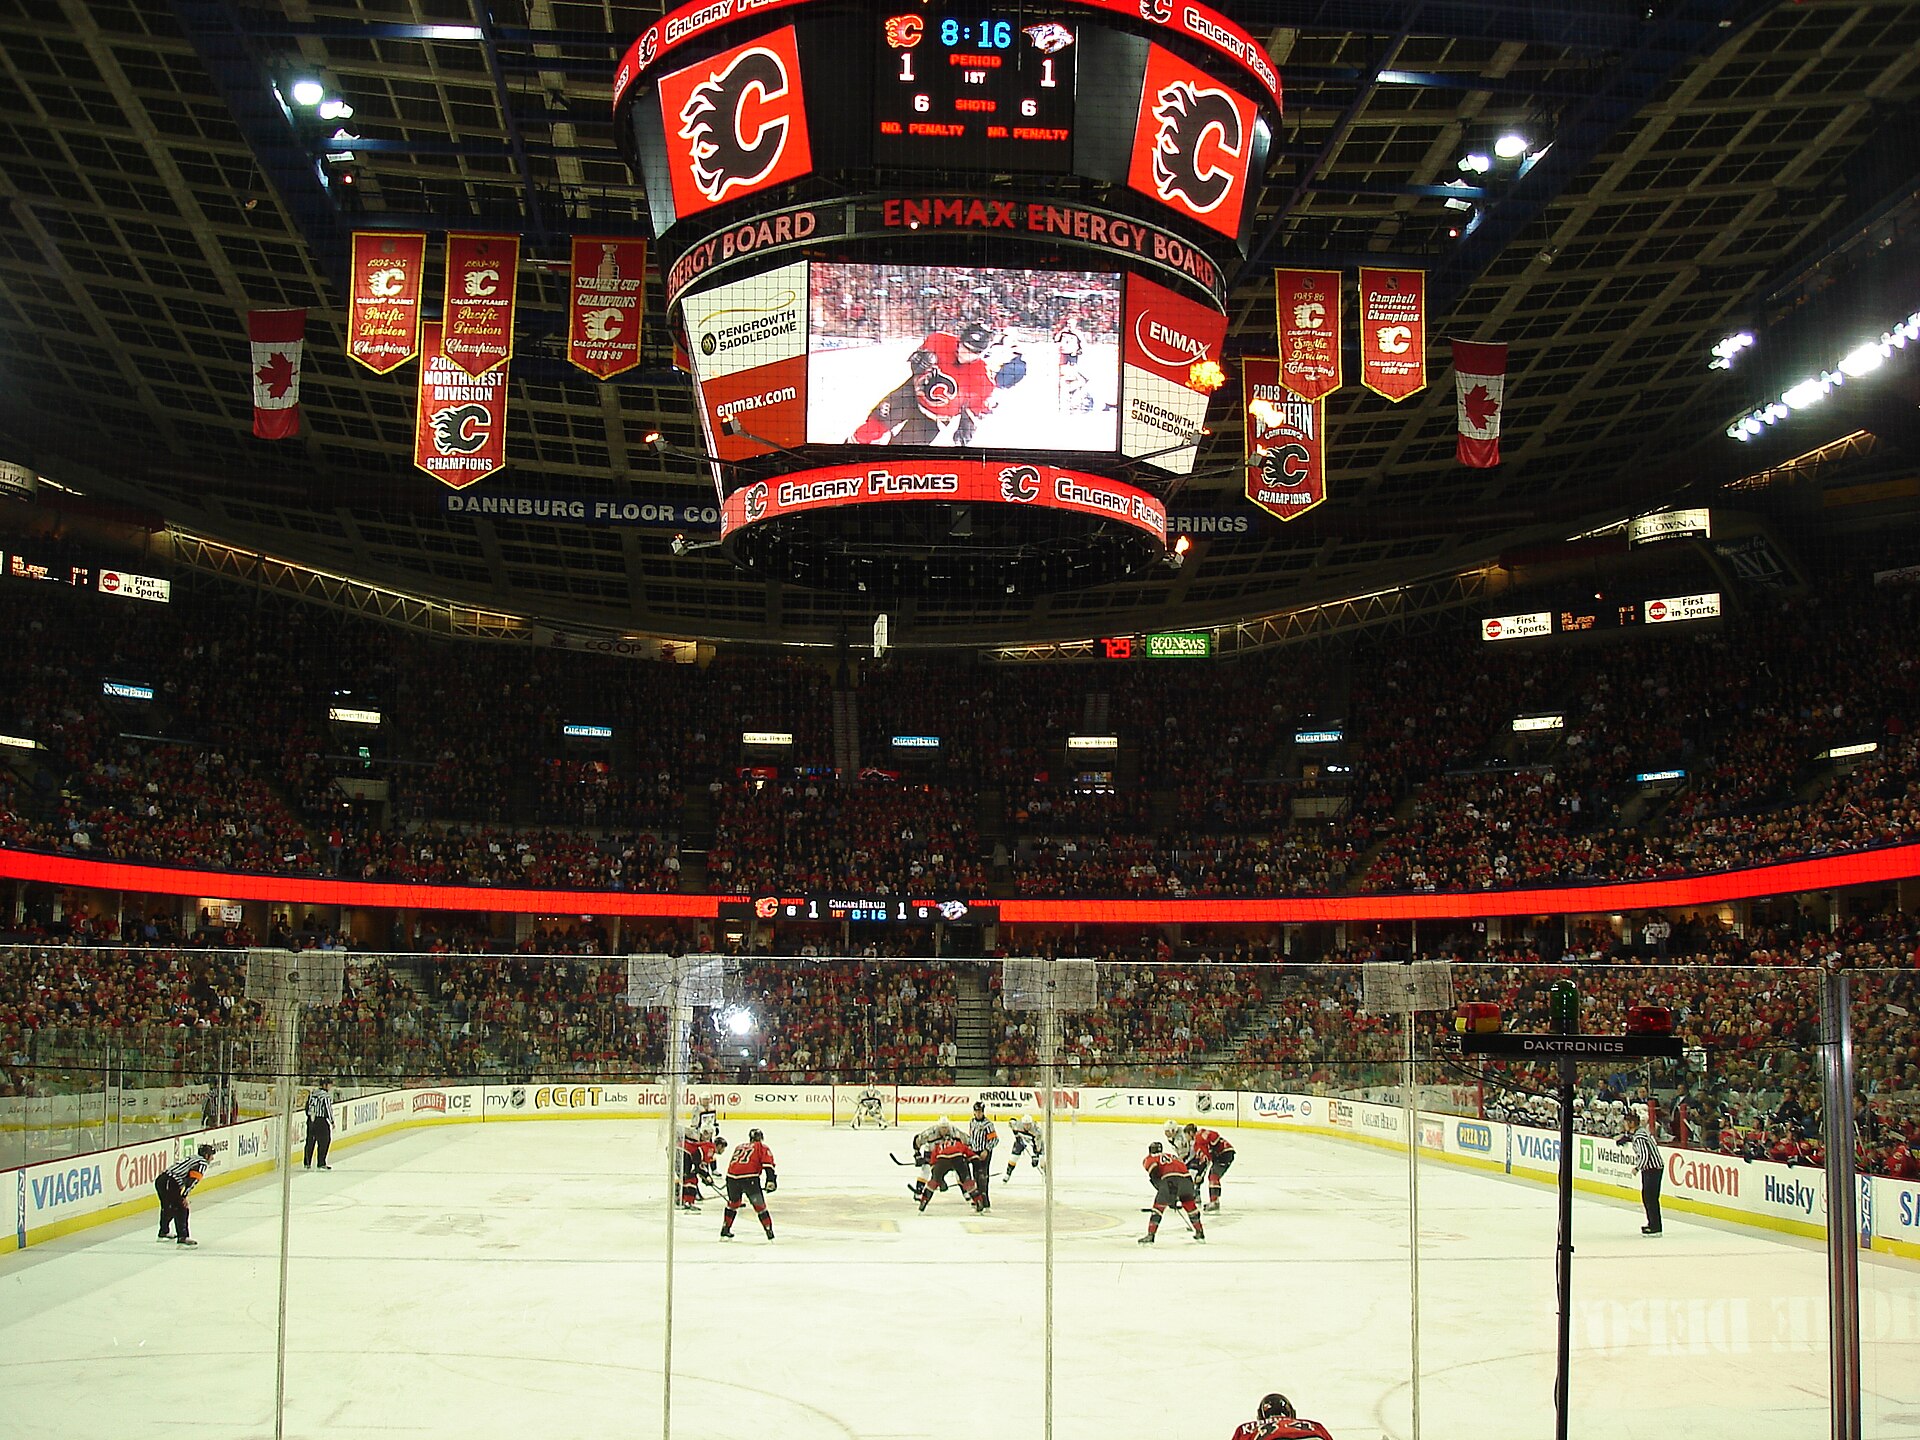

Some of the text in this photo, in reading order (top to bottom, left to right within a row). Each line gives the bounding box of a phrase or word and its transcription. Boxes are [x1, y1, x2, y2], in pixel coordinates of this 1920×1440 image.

[665, 1, 734, 44] CALGARY
[941, 19, 1011, 48] 8:16
[1184, 8, 1244, 57] CALGARY
[899, 54, 914, 81] 1
[950, 54, 1001, 68] PERIOD
[1040, 59, 1056, 88] 1
[914, 94, 930, 112] 6
[955, 99, 996, 112] SHOTS
[1020, 99, 1037, 117] 6
[909, 123, 964, 136] PENALTY
[1013, 127, 1069, 140] PENALTY
[722, 211, 815, 259] BOARD
[884, 199, 1214, 287] ENMAX ENERGY BOARD
[620, 280, 640, 291] CUP
[577, 293, 637, 308] CHAMPIONS
[1369, 291, 1416, 304] Campbell
[364, 306, 405, 326] Pacific
[457, 305, 499, 325] Pacific
[1367, 309, 1420, 323] Champions
[359, 322, 407, 337] Division
[453, 320, 502, 336] Division
[718, 310, 796, 340] PENGROWTH
[719, 322, 797, 351] SADDLEDOME
[1149, 320, 1211, 360] ENMAX
[353, 339, 411, 357] Champions
[445, 338, 507, 357] Champions
[434, 386, 493, 401] DIVISION
[1253, 384, 1280, 400] 2003
[716, 386, 796, 420] enmax.com
[1132, 398, 1195, 429] PENGROWTH
[426, 457, 493, 471] CHAMPIONS
[778, 470, 958, 507] CALGARY FLAMES
[1055, 477, 1132, 515] CALGARY
[1257, 489, 1312, 505] CHAMPIONS
[448, 495, 584, 518] DANNBURG
[595, 503, 674, 521] FLOOR
[1634, 519, 1697, 536] KELOWNA
[123, 583, 133, 593] in
[134, 576, 155, 588] First
[1682, 597, 1703, 607] First
[1516, 616, 1536, 625] First
[1671, 609, 1681, 617] in
[786, 901, 818, 918] 6 1
[851, 910, 887, 919] 8:16
[897, 902, 928, 920] 1 6
[1523, 1040, 1624, 1052] DAKTRONICS
[412, 1092, 471, 1112] SMIRNOFF ICE
[486, 1092, 509, 1108] my
[535, 1087, 628, 1109] AGAT Labs
[754, 1093, 848, 1103] SONY BRAVIA
[930, 1094, 970, 1106] Pizza
[979, 1091, 1033, 1101] RRROLL UP
[1126, 1095, 1176, 1107] TELUS
[1253, 1095, 1266, 1111] On
[1267, 1096, 1279, 1111] the
[1278, 1096, 1295, 1113] Run
[1337, 1100, 1353, 1118] Home
[237, 1132, 260, 1157] Husky
[1459, 1126, 1479, 1144] PIZZA
[1480, 1130, 1488, 1146] 73
[115, 1150, 168, 1192] Canon
[1668, 1152, 1739, 1197] Canon
[32, 1165, 102, 1210] VIAGRA
[1764, 1174, 1815, 1214] Husky
